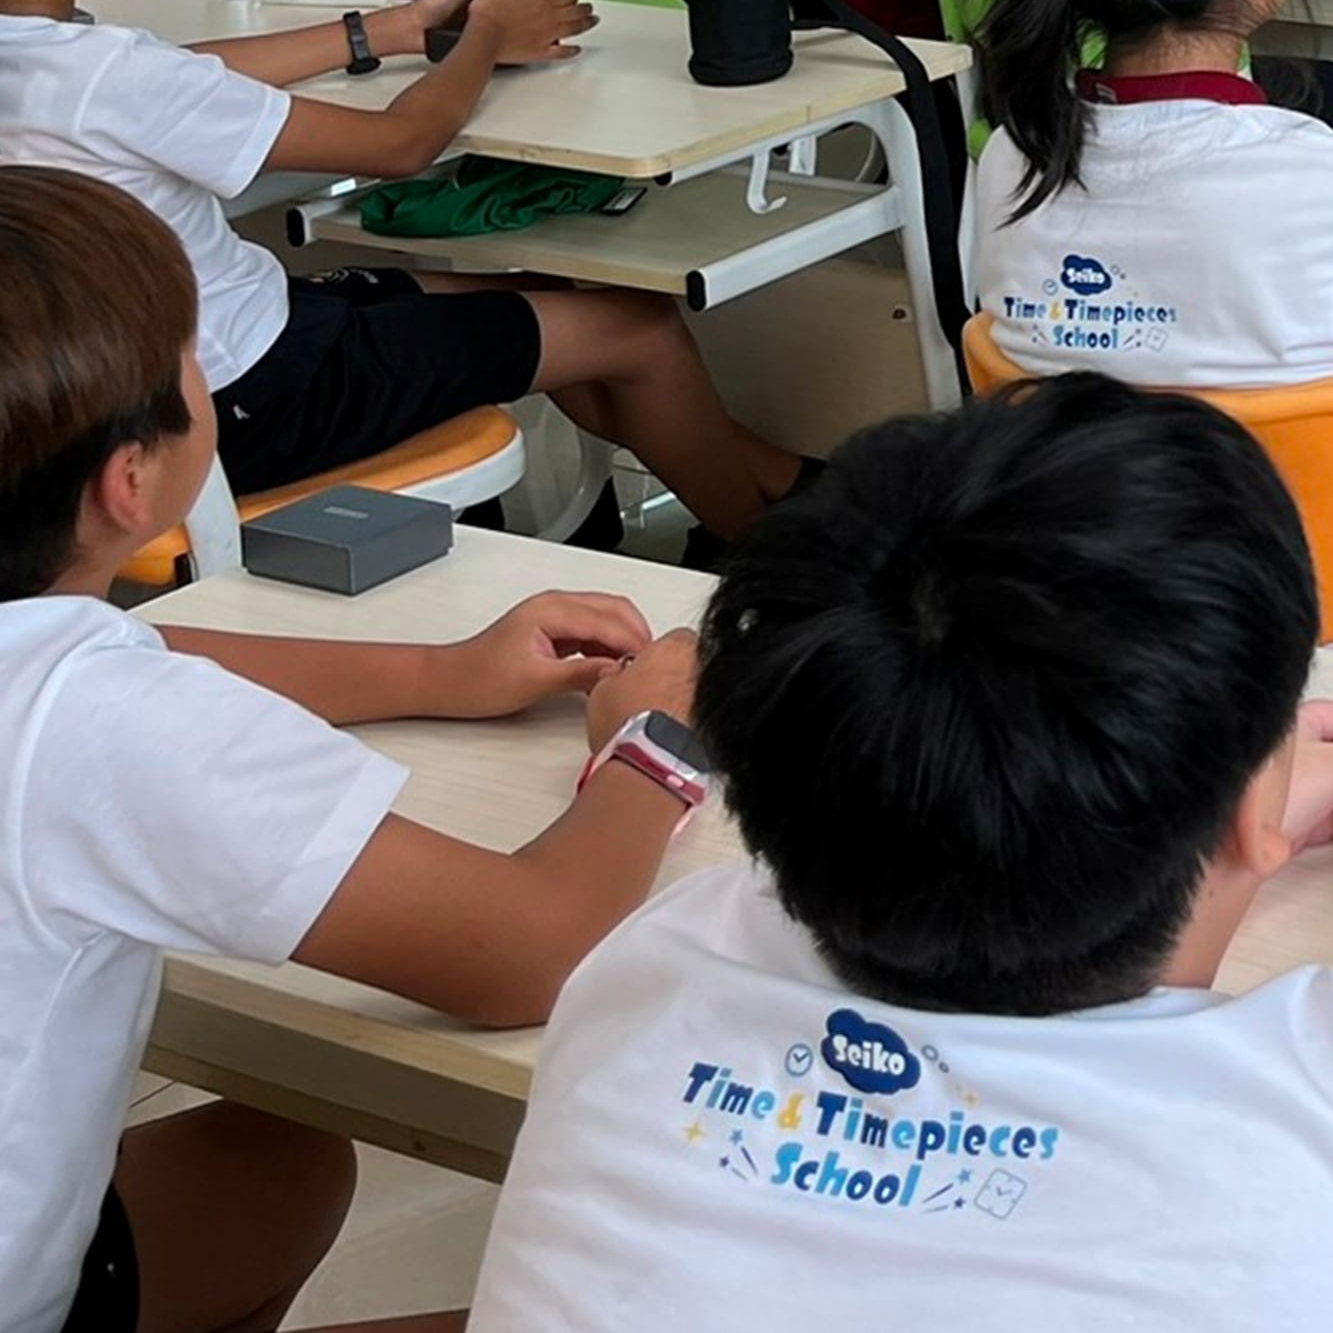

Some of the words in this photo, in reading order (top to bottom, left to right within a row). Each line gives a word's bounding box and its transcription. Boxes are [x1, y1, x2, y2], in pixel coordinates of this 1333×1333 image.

[1004, 296, 1047, 319] Time
[1064, 299, 1177, 325] Timepieces
[1053, 325, 1119, 349] School
[830, 1034, 905, 1075] Seiko
[682, 1062, 775, 1121] Time
[776, 1093, 802, 1131] &
[815, 1090, 1060, 1161] Timepieces
[770, 1141, 923, 1208] School
